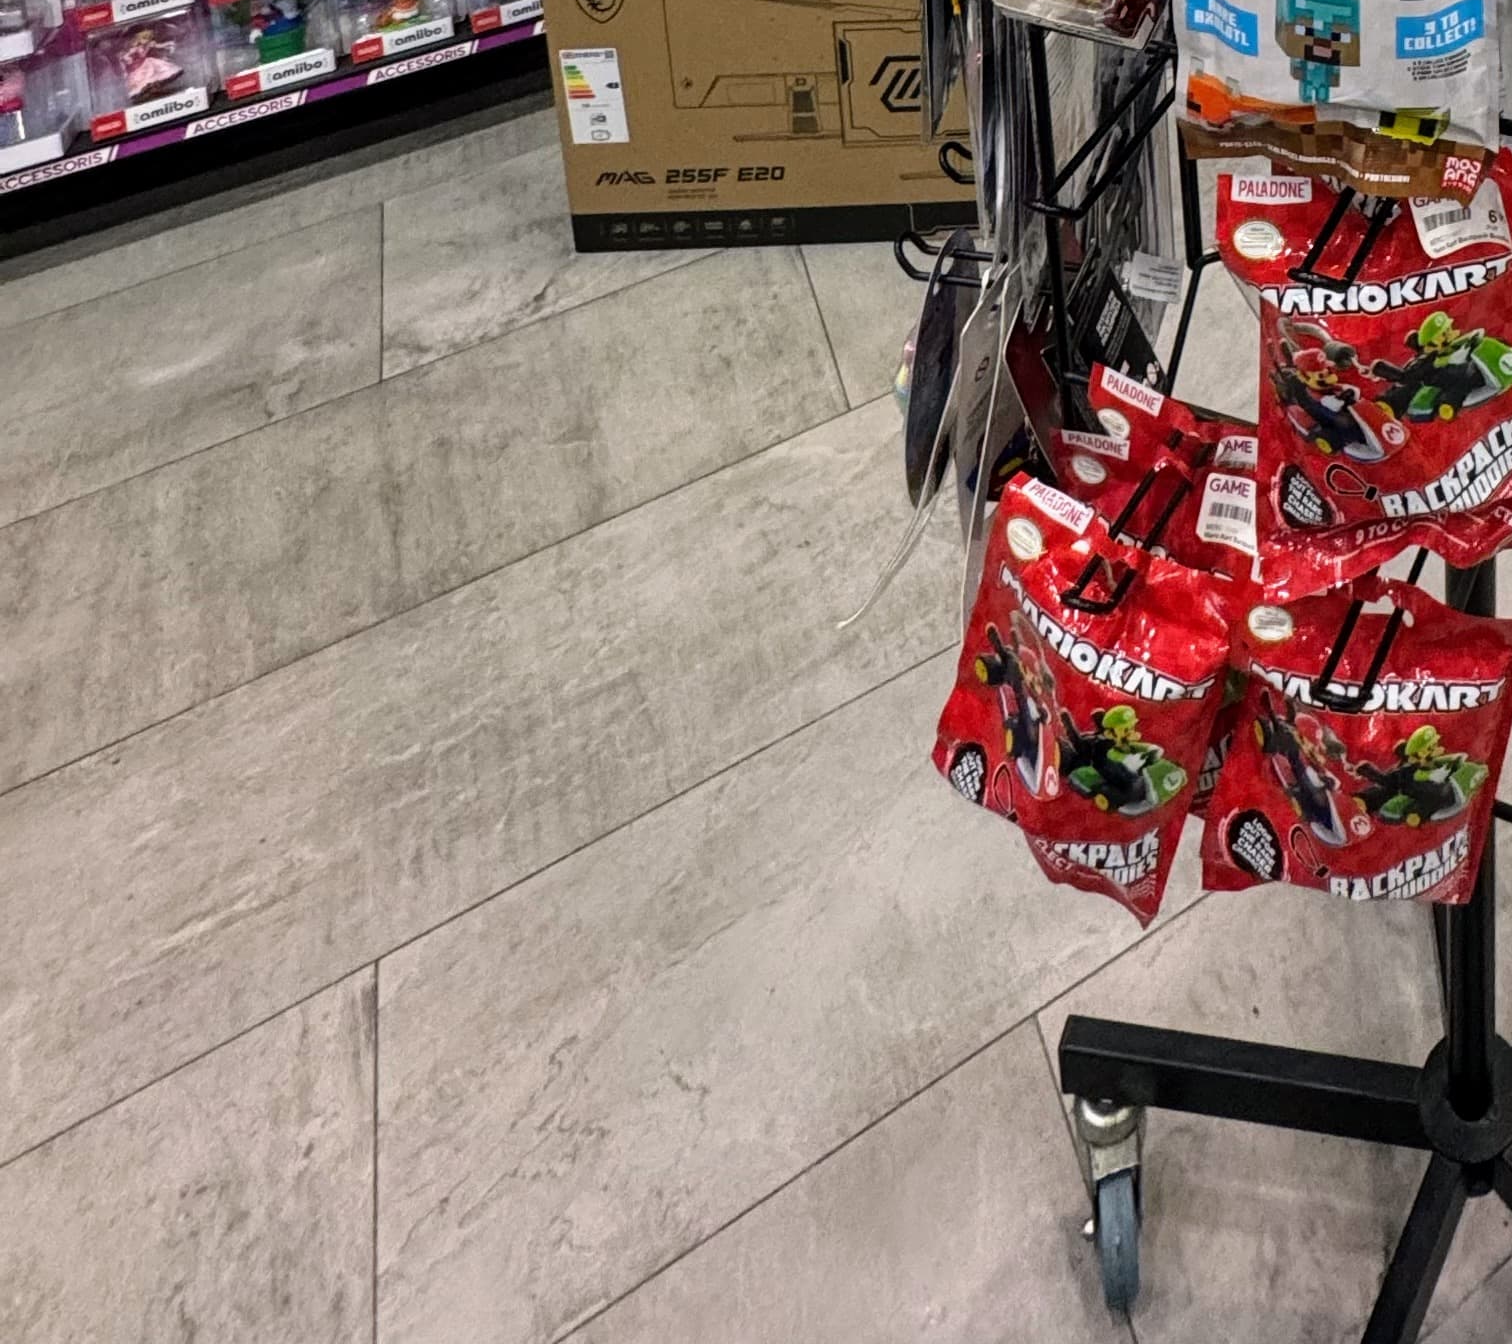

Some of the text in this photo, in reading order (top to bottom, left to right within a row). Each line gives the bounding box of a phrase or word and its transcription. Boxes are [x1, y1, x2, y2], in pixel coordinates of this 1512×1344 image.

[1439, 12, 1460, 30] TO
[395, 23, 443, 48] amiibo
[1403, 19, 1478, 52] COLLECT!
[272, 57, 325, 83] amiibo
[375, 45, 467, 82] ACCESSORIS
[192, 95, 295, 137] ACCESSORIS
[595, 166, 785, 186] MAG 255F E20
[1238, 179, 1306, 199] PALADONE
[1106, 375, 1159, 412] PALADONE
[1209, 477, 1251, 498] GAME
